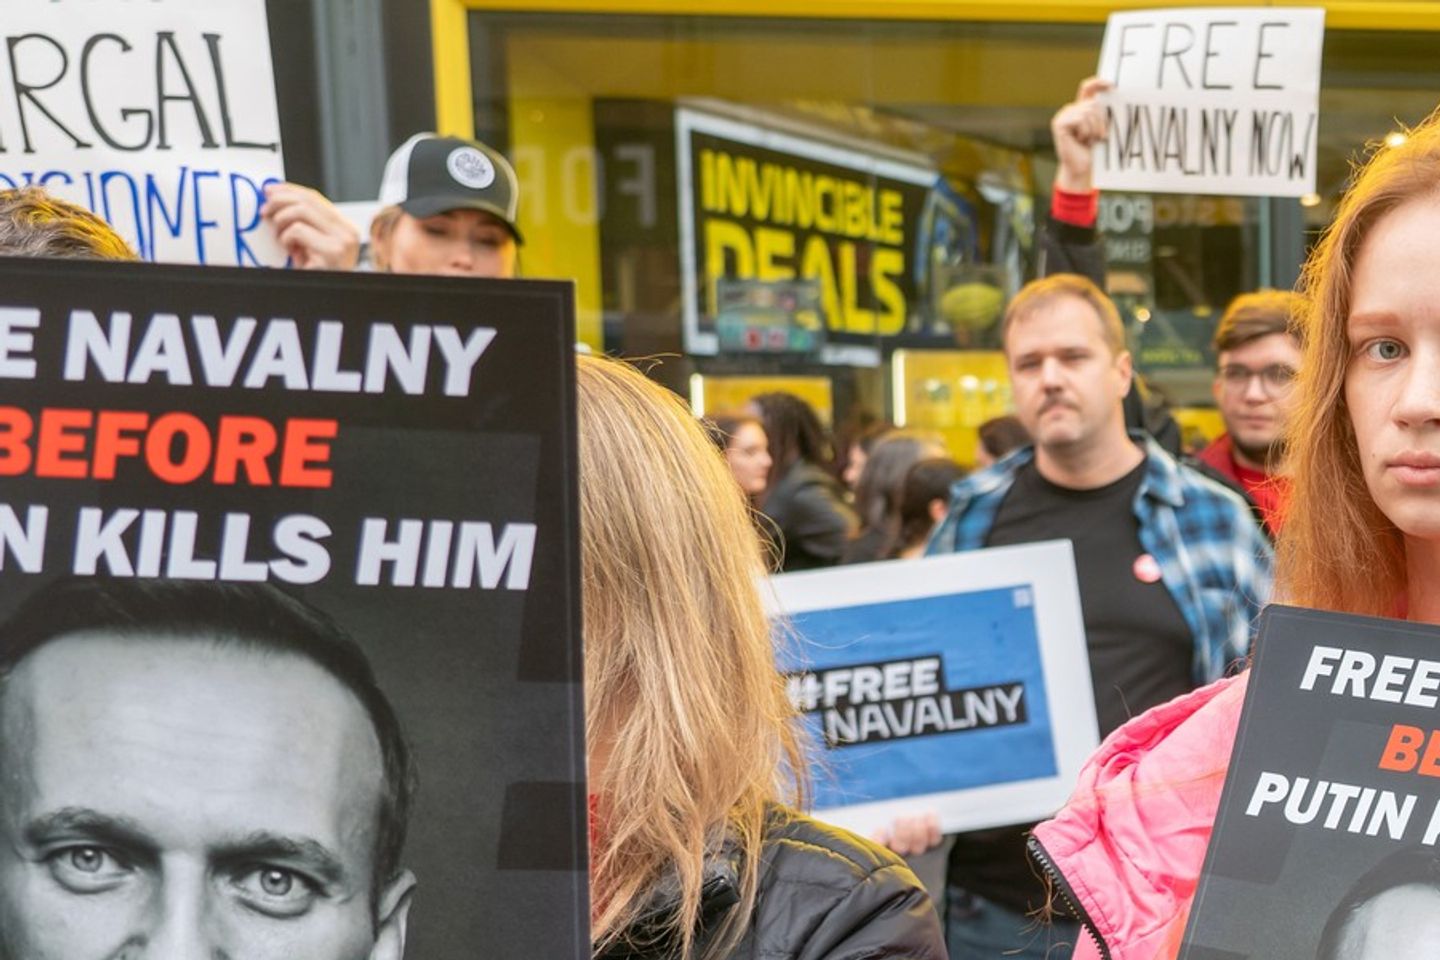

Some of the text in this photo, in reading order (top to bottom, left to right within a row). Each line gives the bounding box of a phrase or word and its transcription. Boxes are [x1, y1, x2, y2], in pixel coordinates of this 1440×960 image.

[0, 32, 279, 153] RGAL
[1115, 22, 1291, 90] FREE
[1105, 104, 1315, 180] NAVALNY NOW
[702, 149, 904, 247] INVINCIBLE
[705, 219, 905, 338] DEALS
[64, 310, 497, 397] NAVALNY
[0, 407, 338, 488] BEFORE
[73, 508, 333, 584] KILLS
[355, 518, 537, 591] HIM
[785, 656, 940, 711] #FREE
[825, 685, 1024, 743] NAVALNY
[1245, 771, 1417, 840] PUTIN
